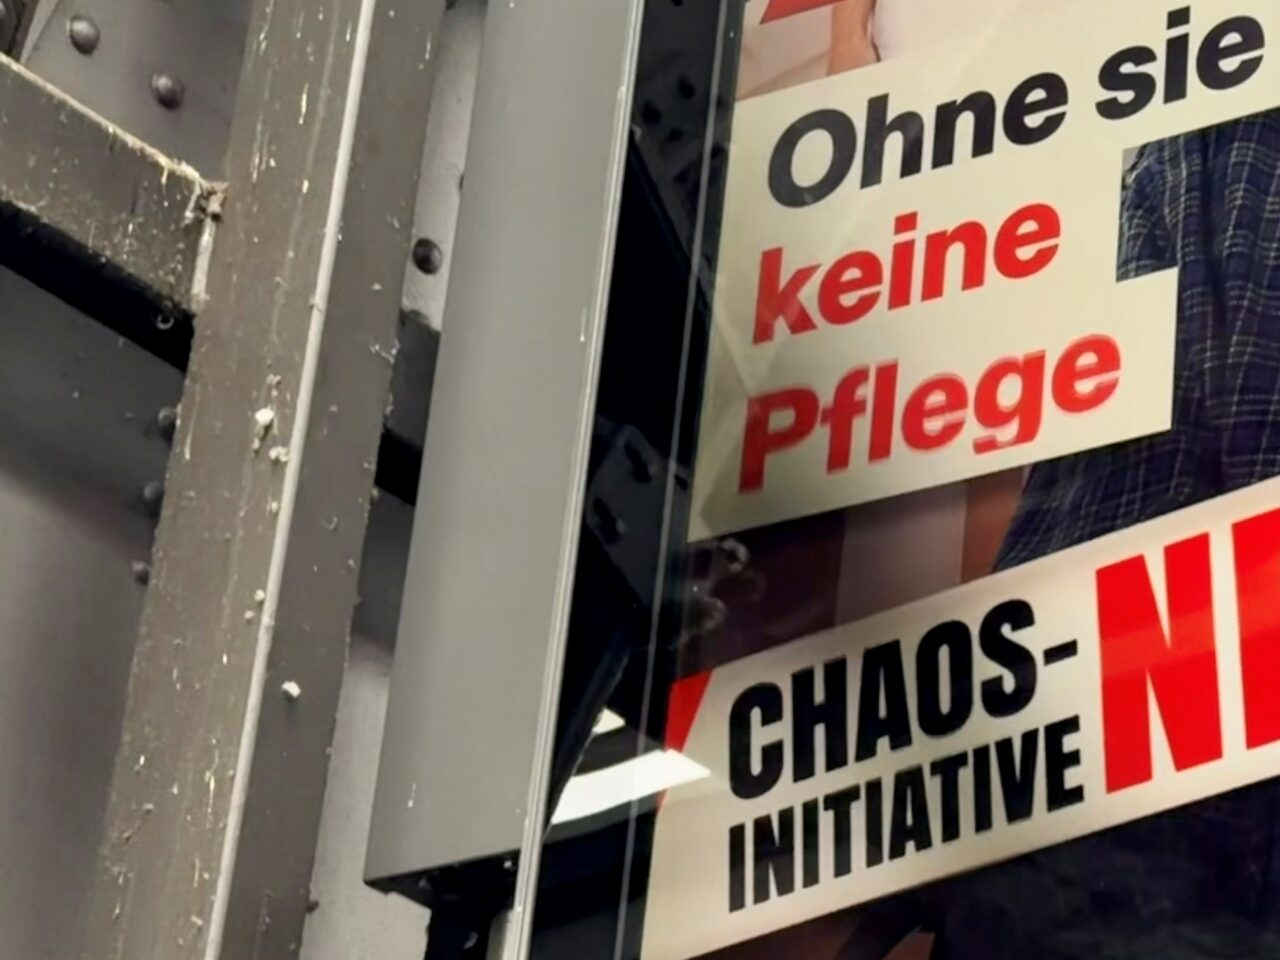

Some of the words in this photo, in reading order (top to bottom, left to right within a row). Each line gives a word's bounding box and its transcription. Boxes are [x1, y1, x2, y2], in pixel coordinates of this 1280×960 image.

[766, 71, 1070, 209] Ohne
[1094, 4, 1267, 121] sie
[751, 202, 1061, 345] keine
[737, 334, 1122, 495] Pflege
[727, 597, 1080, 801] CHAOS-
[727, 713, 1084, 914] INITIATIVE
